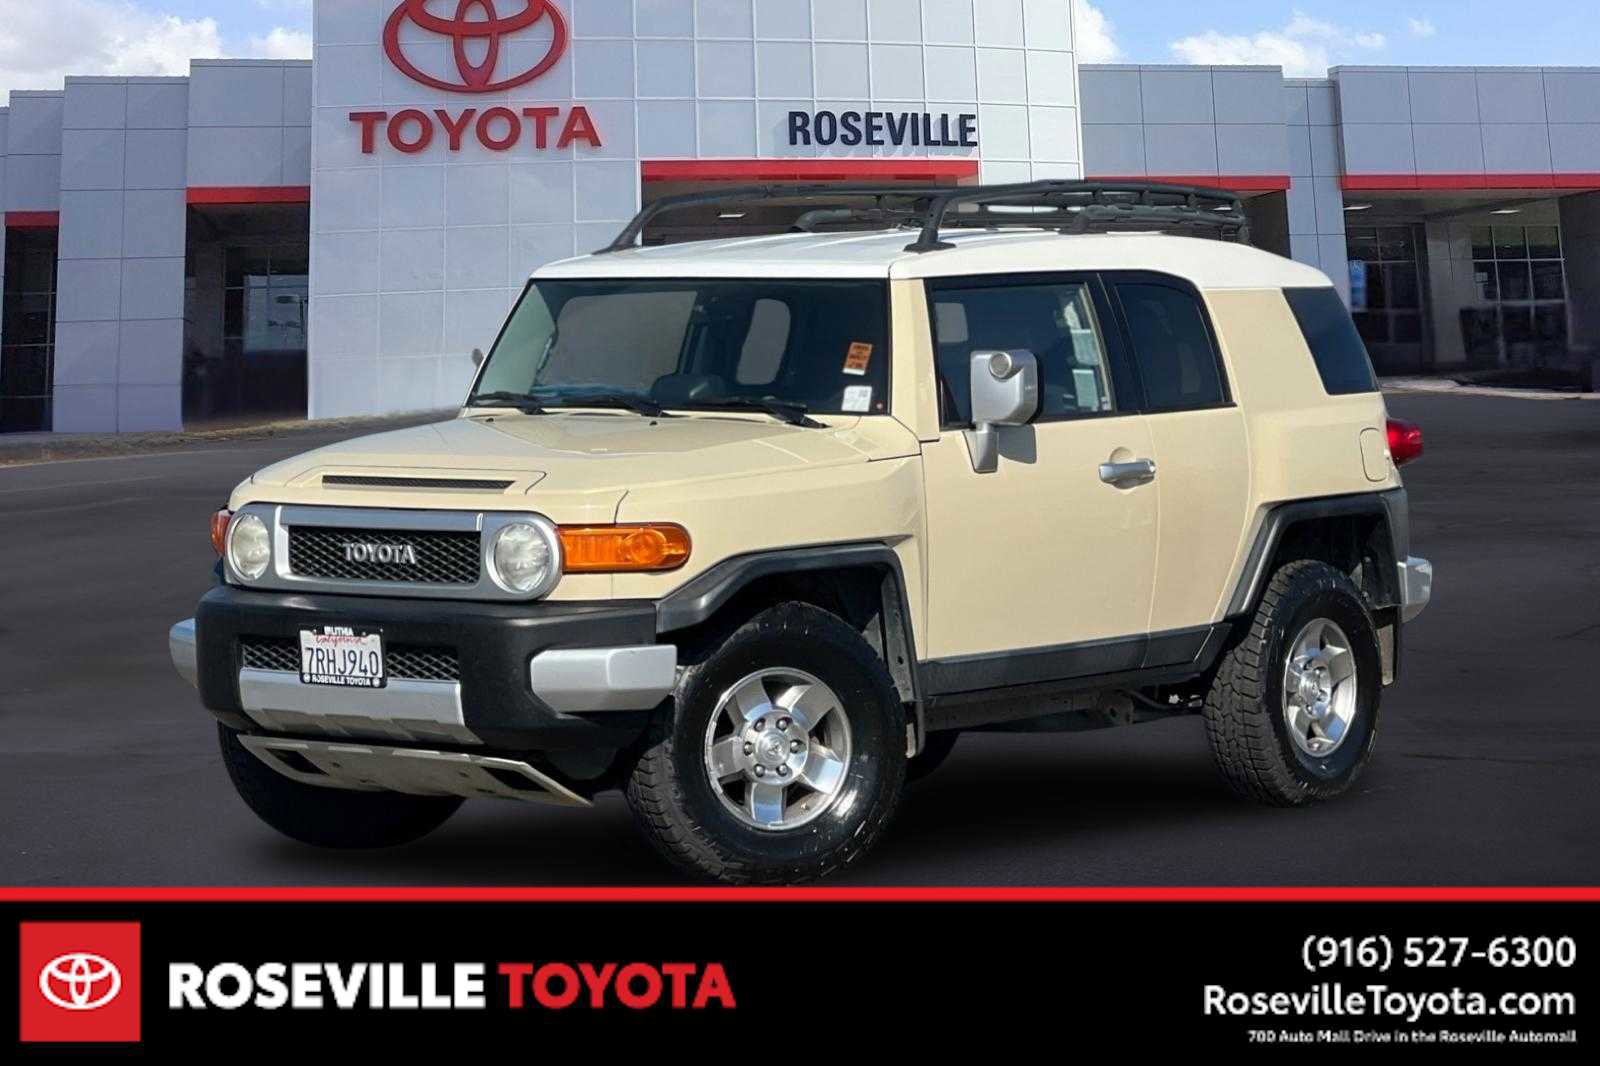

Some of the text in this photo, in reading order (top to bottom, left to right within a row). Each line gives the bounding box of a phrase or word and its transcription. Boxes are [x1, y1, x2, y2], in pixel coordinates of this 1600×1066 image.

[349, 106, 602, 154] TOYOTA
[788, 110, 979, 148] ROSEVILLE
[343, 543, 416, 564] TOYOTA
[304, 647, 379, 676] 7RHJ940
[312, 675, 371, 686] ROSEVILLE TOYOTA
